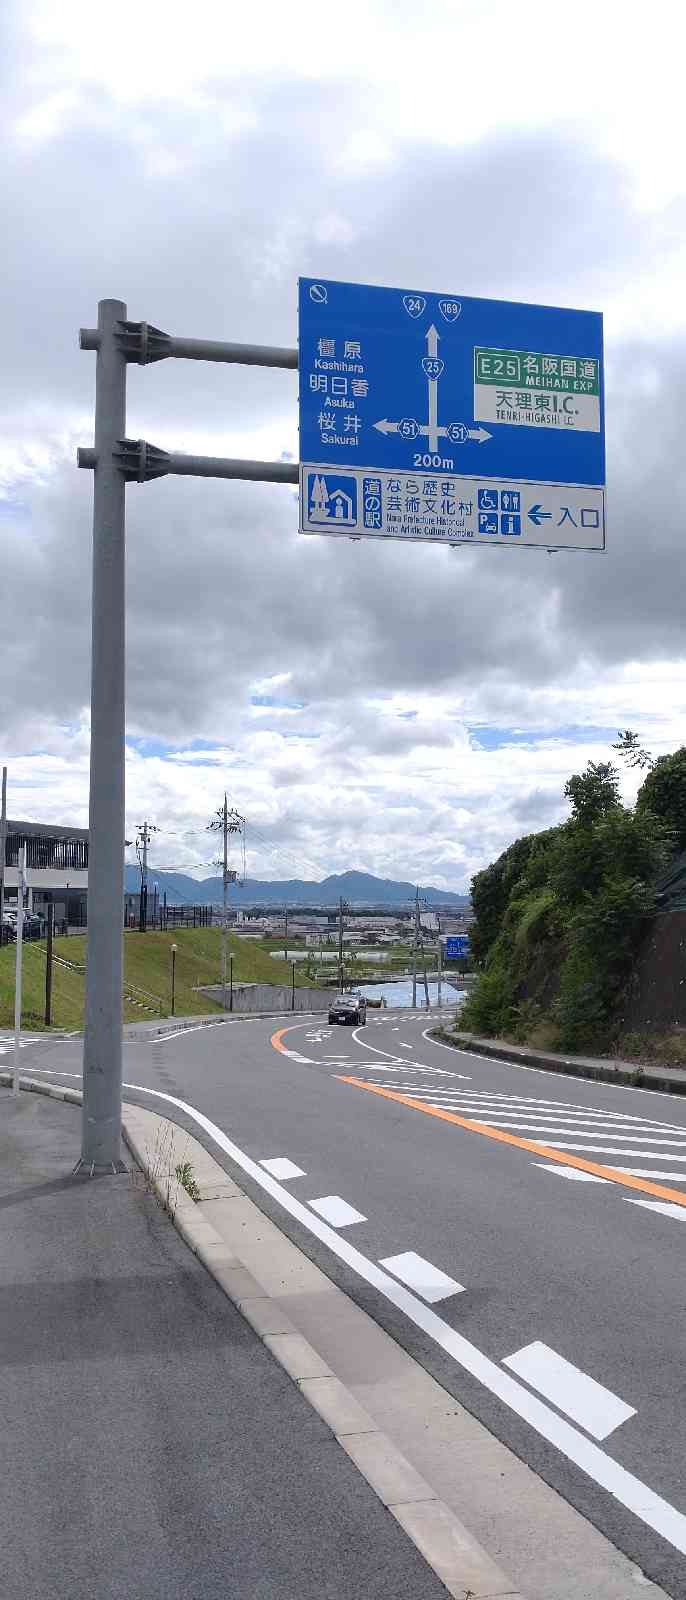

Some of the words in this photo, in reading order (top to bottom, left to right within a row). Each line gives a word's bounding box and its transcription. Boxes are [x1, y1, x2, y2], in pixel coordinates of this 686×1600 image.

[408, 300, 420, 311] 24
[444, 303, 457, 314] 169
[314, 359, 364, 373] Kashihara
[426, 361, 439, 373] 25
[481, 358, 516, 376] E25
[523, 355, 596, 379] 名阪国道
[309, 374, 369, 397] 明日香
[525, 375, 569, 389] MEIHAN
[573, 381, 593, 391] EXP
[324, 397, 355, 409] Asuka
[495, 390, 579, 415] 天理東I.C.
[317, 411, 362, 433] 桜井
[496, 409, 560, 424] TENRI-HIGASHI
[402, 422, 415, 434] 51
[451, 427, 464, 439] 51
[320, 433, 359, 446] Sakurai
[413, 453, 454, 470] 200m
[386, 478, 456, 497] なら歴史
[364, 479, 381, 527] 道の駅
[386, 496, 473, 516] 芸術文化村
[386, 513, 402, 523] Nara
[556, 506, 600, 528] 入口
[387, 525, 398, 533] and
[424, 526, 446, 536] Culture
